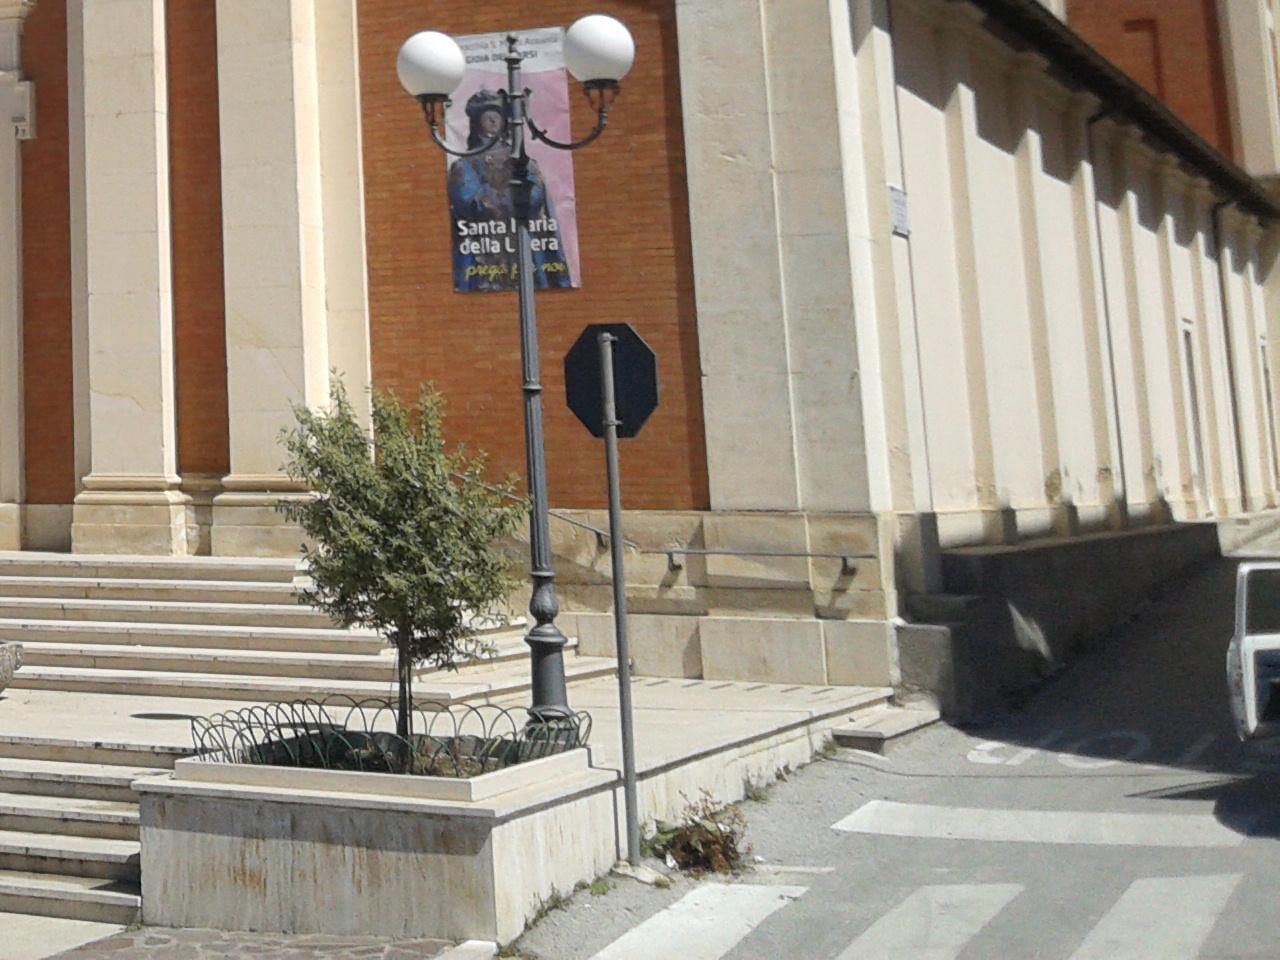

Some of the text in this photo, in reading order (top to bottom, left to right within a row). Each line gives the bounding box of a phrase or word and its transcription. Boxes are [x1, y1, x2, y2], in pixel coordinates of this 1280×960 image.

[457, 219, 506, 236] Santa
[460, 236, 558, 255] della Lera
